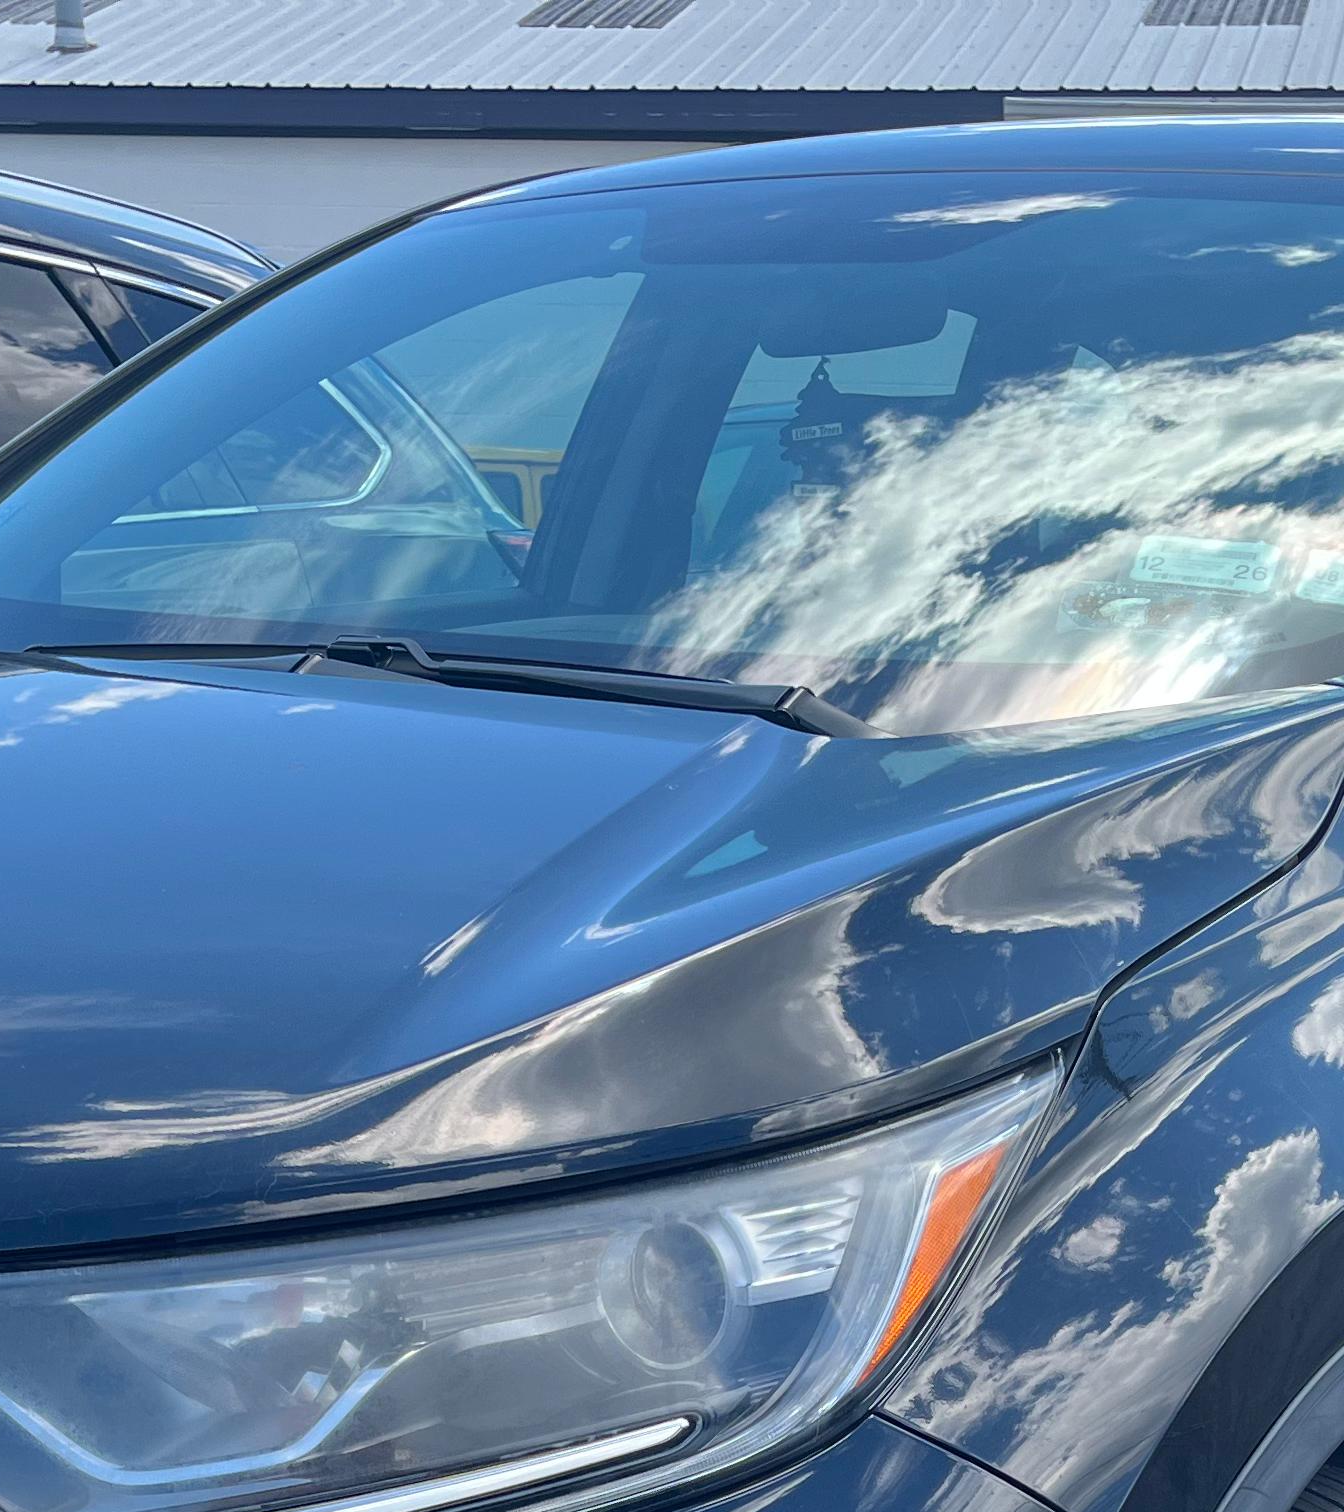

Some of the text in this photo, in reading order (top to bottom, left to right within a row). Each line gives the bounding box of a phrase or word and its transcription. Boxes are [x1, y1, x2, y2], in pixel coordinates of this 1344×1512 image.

[819, 425, 840, 437] Trees
[1139, 555, 1165, 571] 12
[1233, 564, 1269, 581] 26
